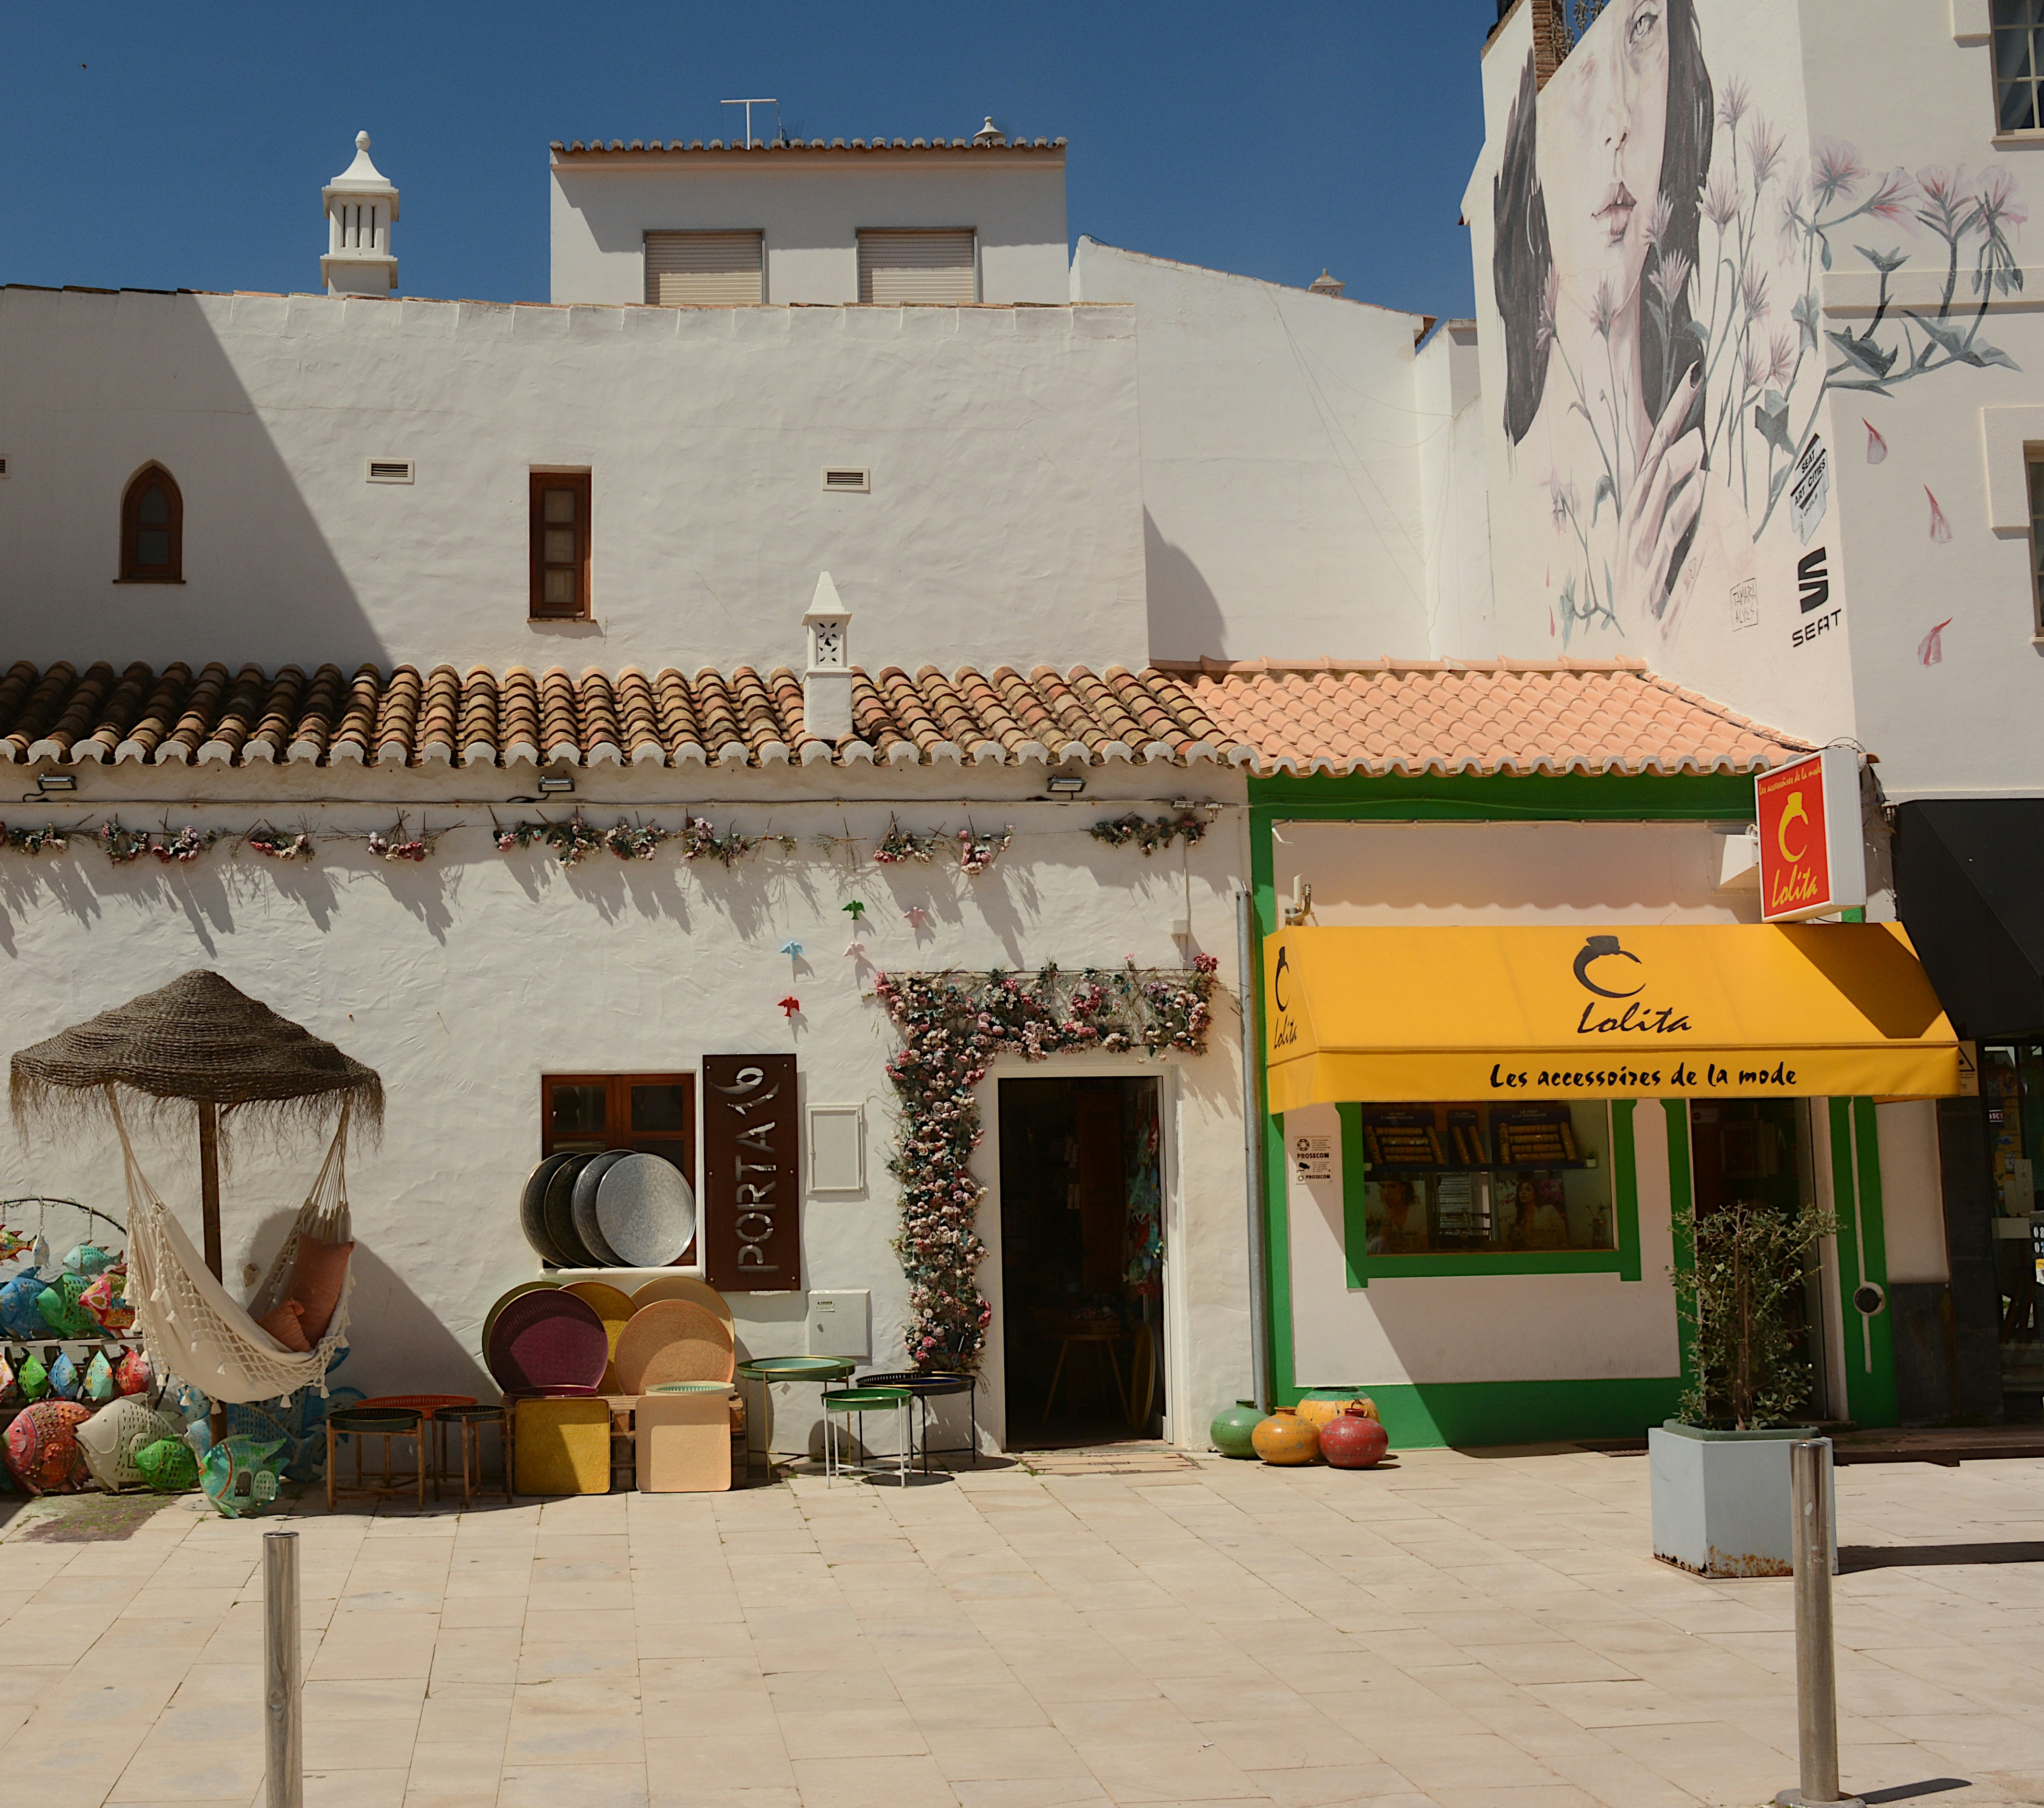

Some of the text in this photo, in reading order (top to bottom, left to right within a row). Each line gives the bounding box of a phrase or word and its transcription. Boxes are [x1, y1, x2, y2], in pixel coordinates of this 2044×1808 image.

[1802, 449, 1815, 474] SEAT
[1794, 458, 1825, 506] ART CITIES
[1792, 608, 1842, 648] SEAT
[1771, 864, 1818, 908] Lolita
[1274, 1014, 1297, 1050] Lolita
[1577, 1002, 1693, 1034] Lolita
[1490, 1061, 1797, 1088] Les accessoires de la mode
[710, 1067, 779, 1273] PORTA 16
